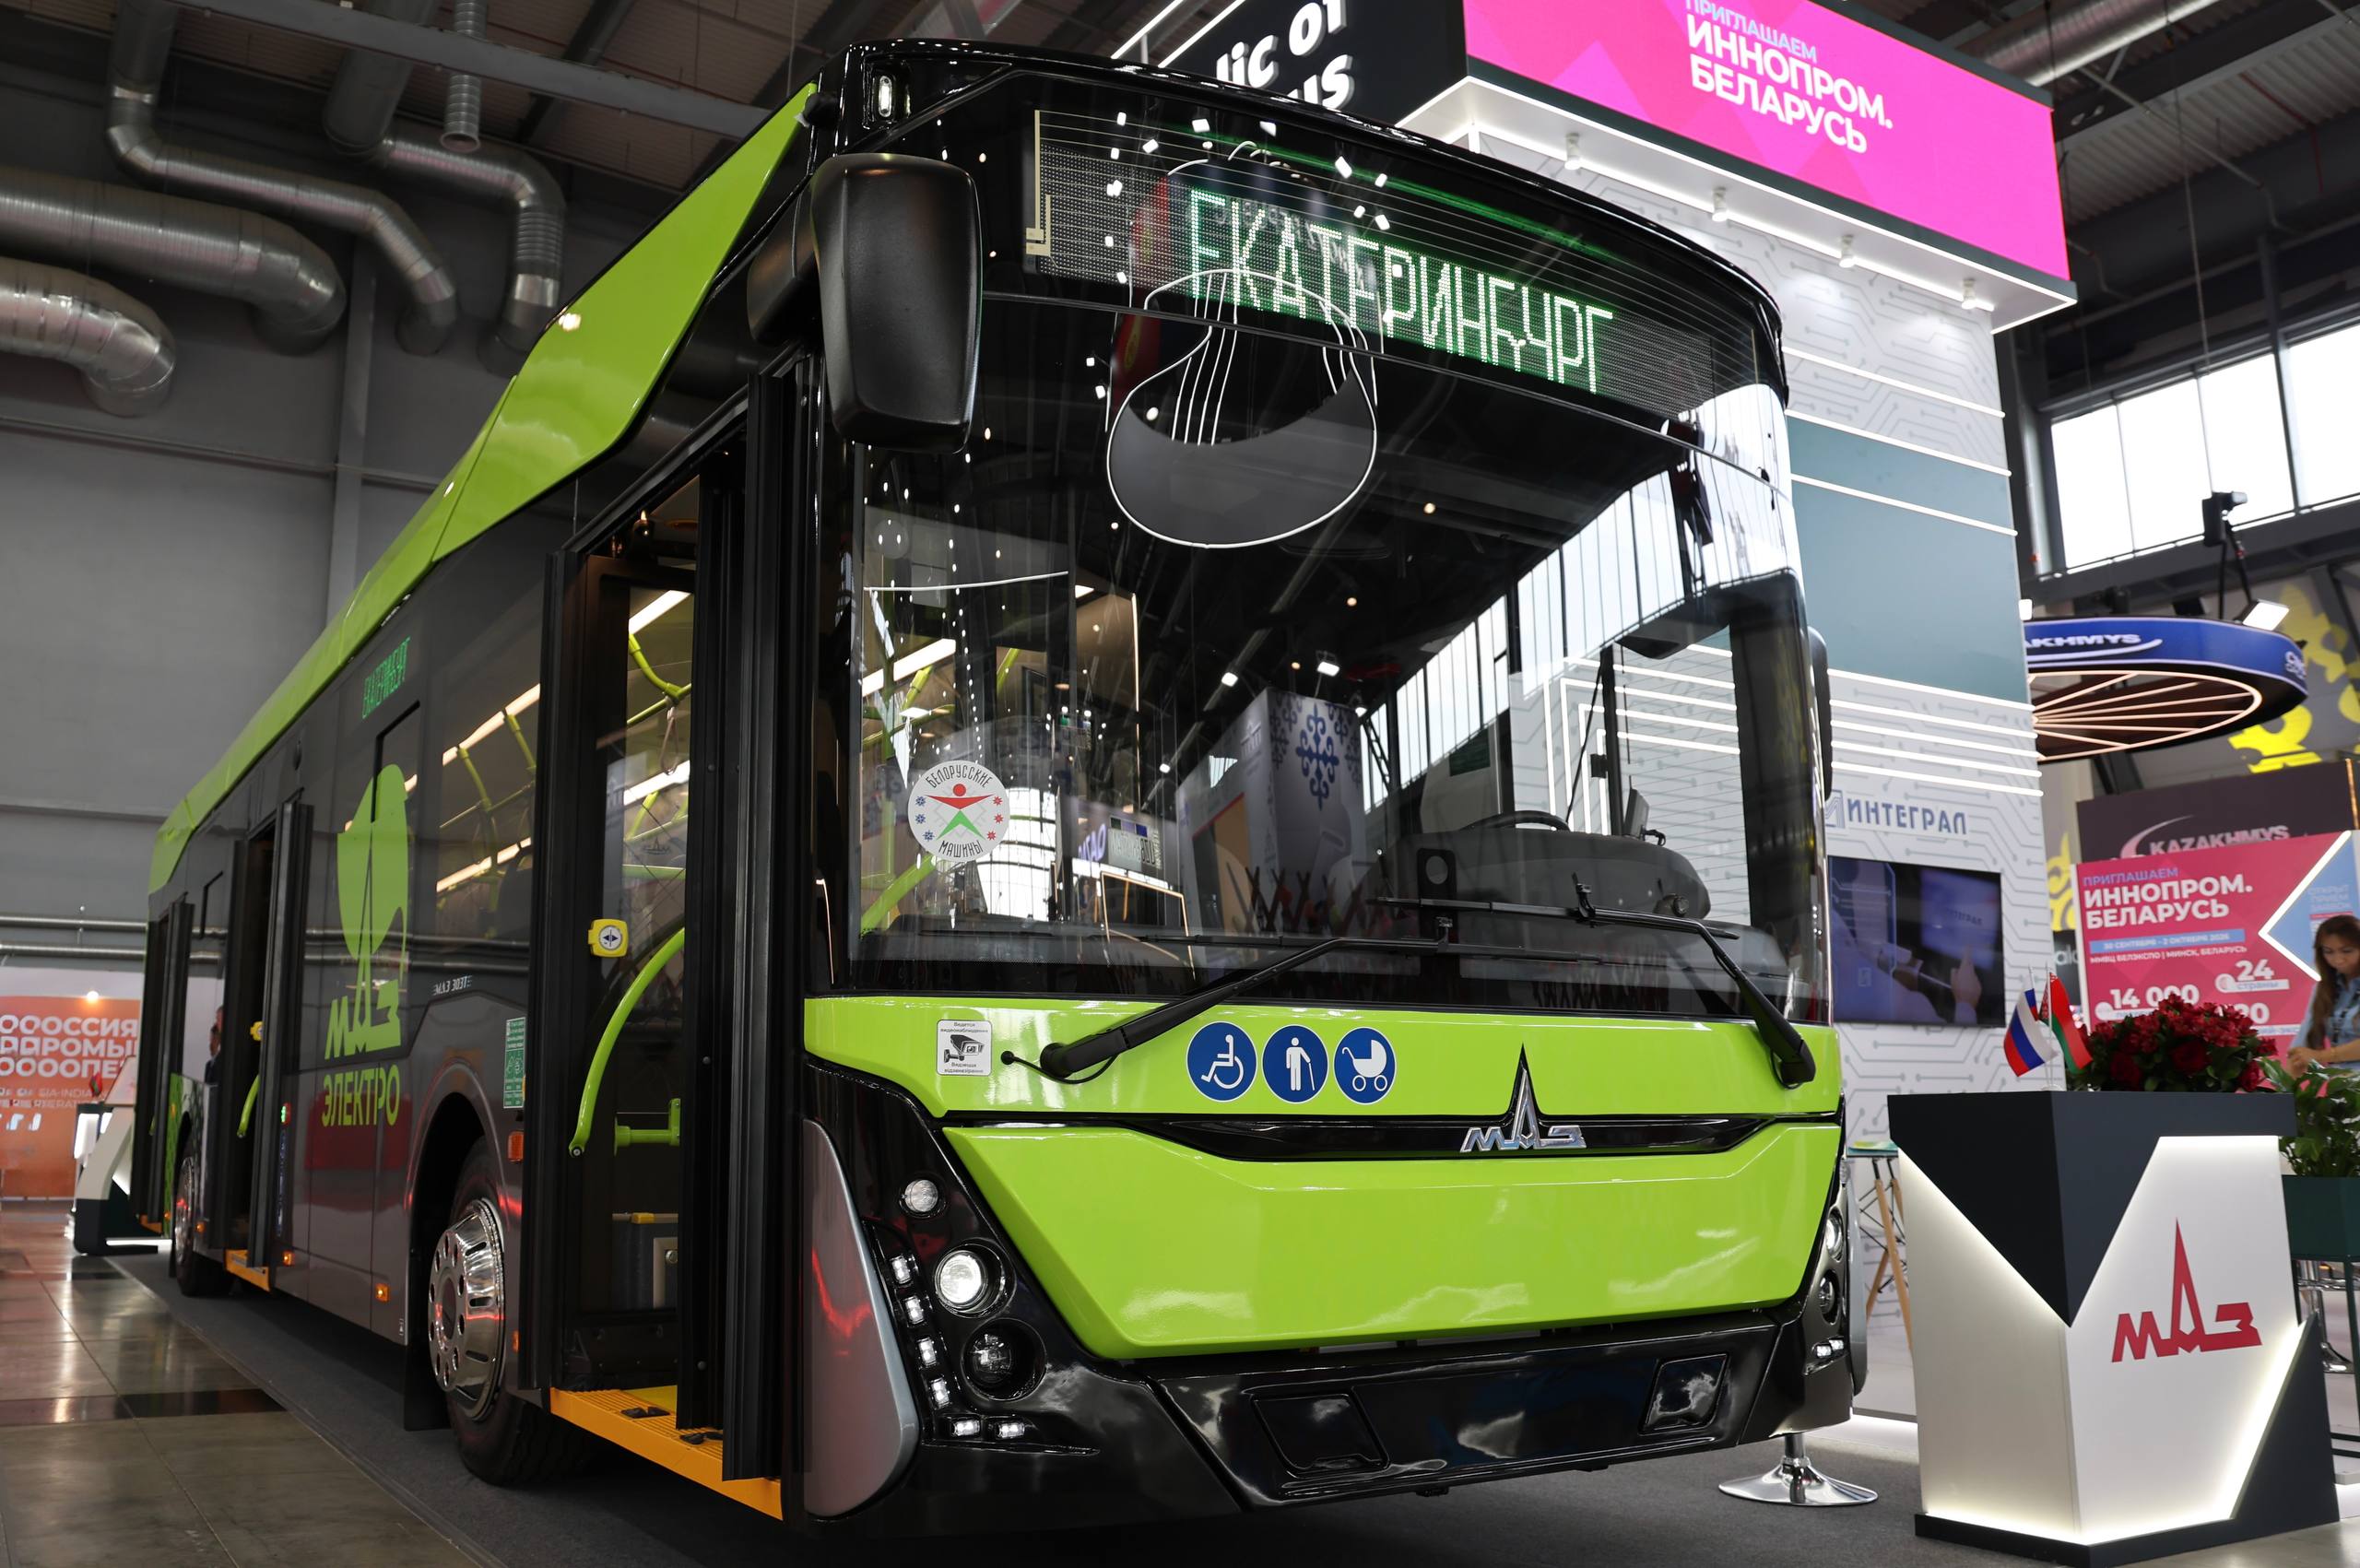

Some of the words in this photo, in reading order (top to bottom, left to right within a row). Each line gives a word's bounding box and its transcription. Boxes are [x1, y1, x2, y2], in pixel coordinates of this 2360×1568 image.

[1686, 0, 1817, 65] ПРИГЛАШАЕМ
[1686, 15, 1894, 129] ИННОПРОМ.
[1690, 53, 1868, 154] БЕЛАРУСЬ
[925, 764, 993, 788] БЕЛОРУССКИЕ
[1847, 797, 1967, 835] ИНТЕГРАЛ
[938, 840, 984, 858] МАШИНЫ
[2083, 867, 2179, 886] ПРИГЛАШАЕМ
[2084, 874, 2253, 909] ИННОПРОМ.
[2086, 899, 2230, 930] БЕЛАРУСЬ
[2235, 959, 2275, 982] 24
[2109, 987, 2141, 1009] 14
[322, 1064, 401, 1127] ЭЛЕКТРО
[2111, 1217, 2263, 1363] МАЗ
